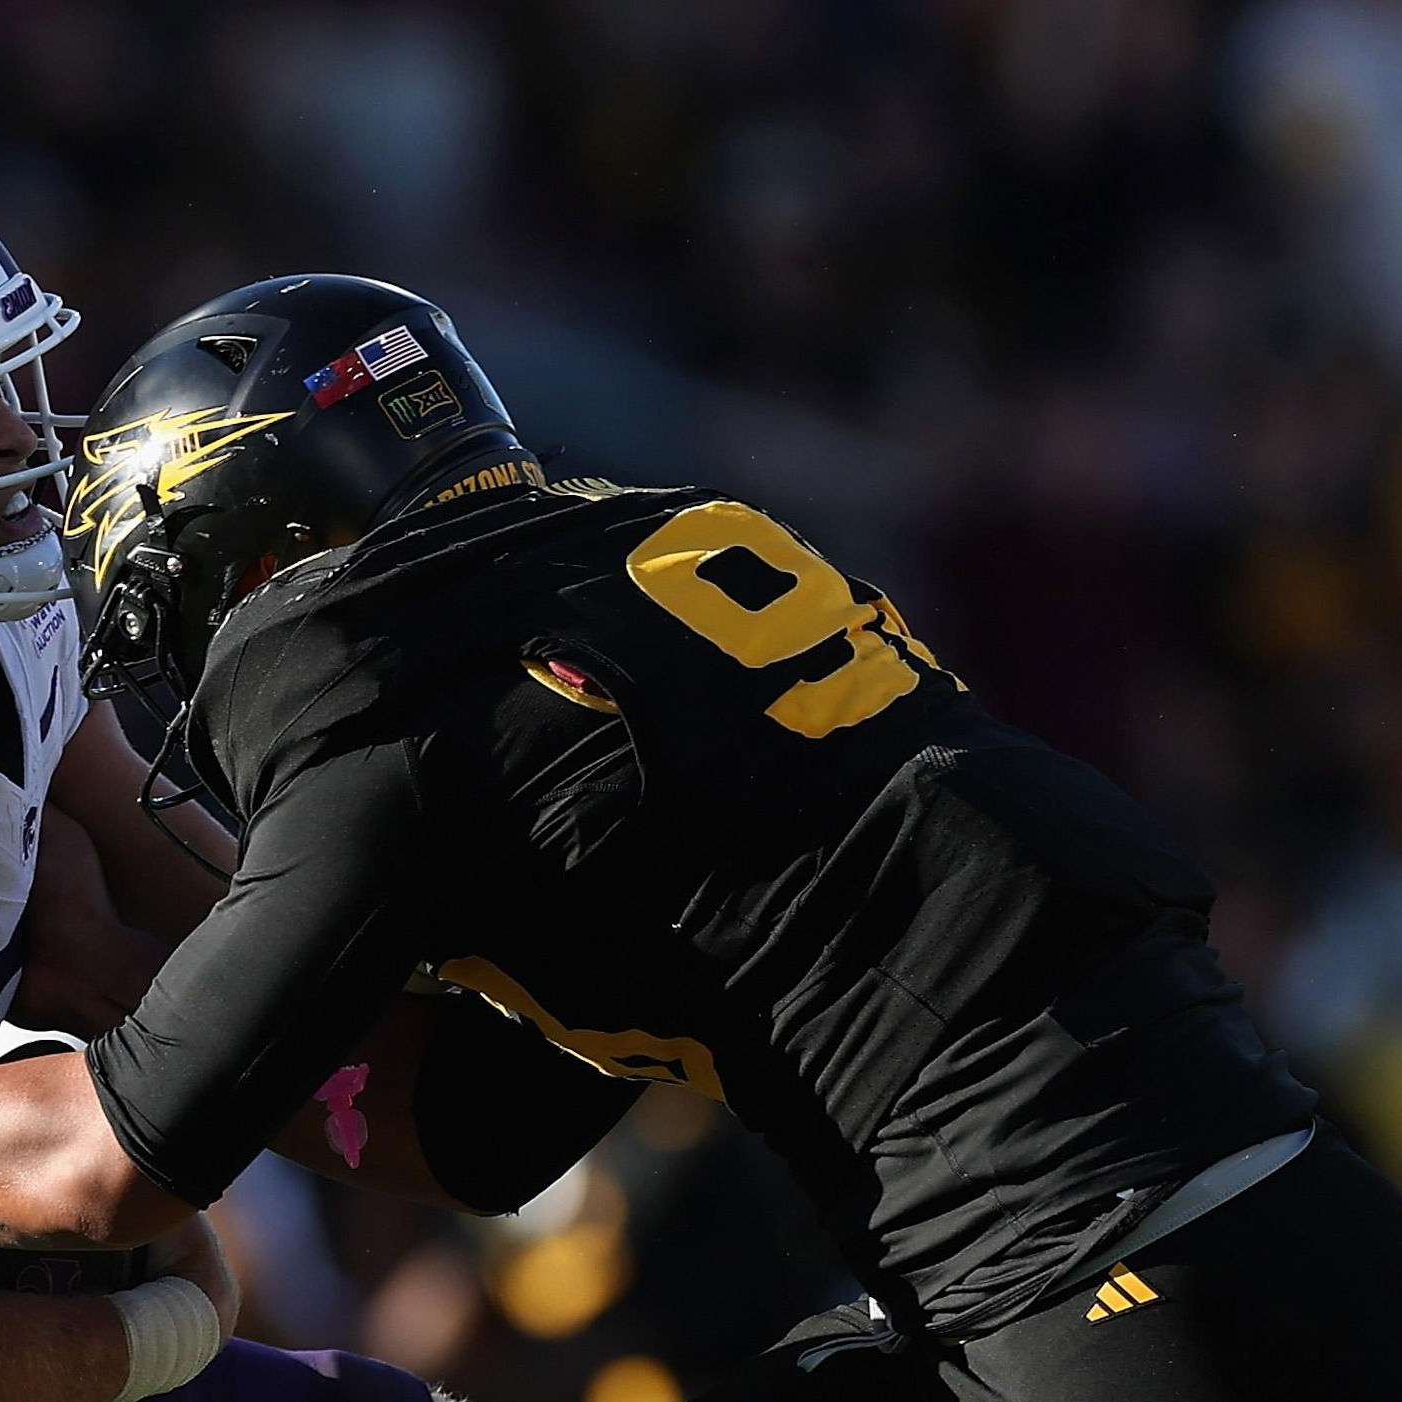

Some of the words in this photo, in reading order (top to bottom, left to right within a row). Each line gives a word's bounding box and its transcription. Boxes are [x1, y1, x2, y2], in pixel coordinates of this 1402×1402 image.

[423, 462, 522, 509] RIZONA
[36, 609, 66, 653] AUCTION
[626, 500, 970, 739] 9
